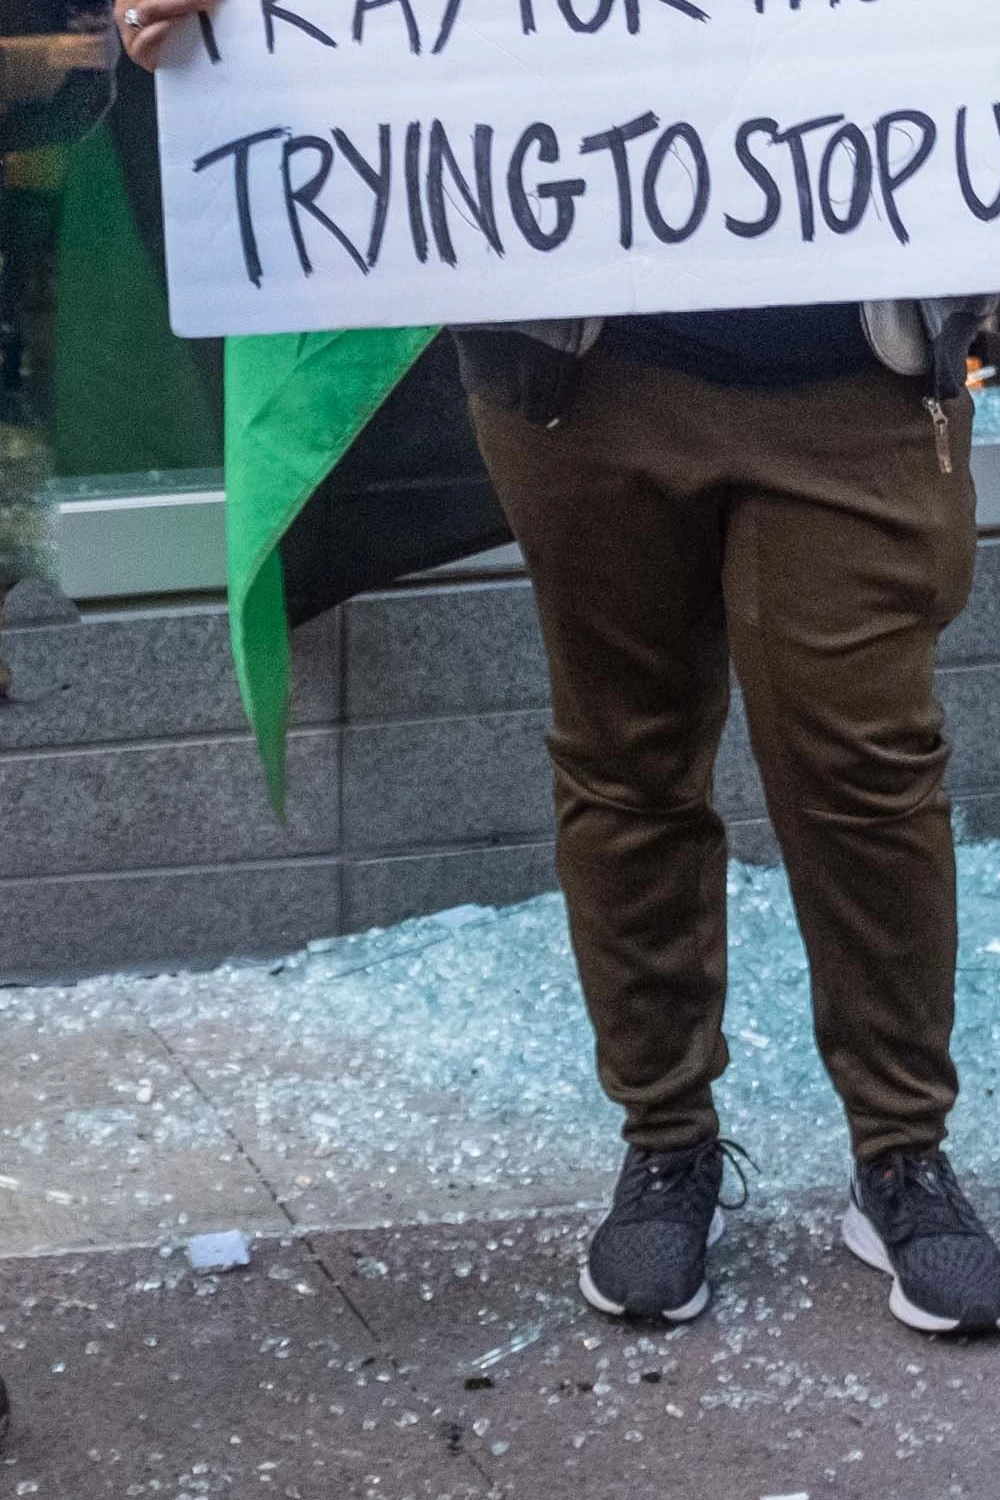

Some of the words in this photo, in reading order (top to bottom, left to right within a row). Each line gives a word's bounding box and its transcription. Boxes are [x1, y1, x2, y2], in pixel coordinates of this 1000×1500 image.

[192, 118, 587, 290] TRYING
[579, 110, 711, 251] TO
[724, 110, 938, 245] STOP
